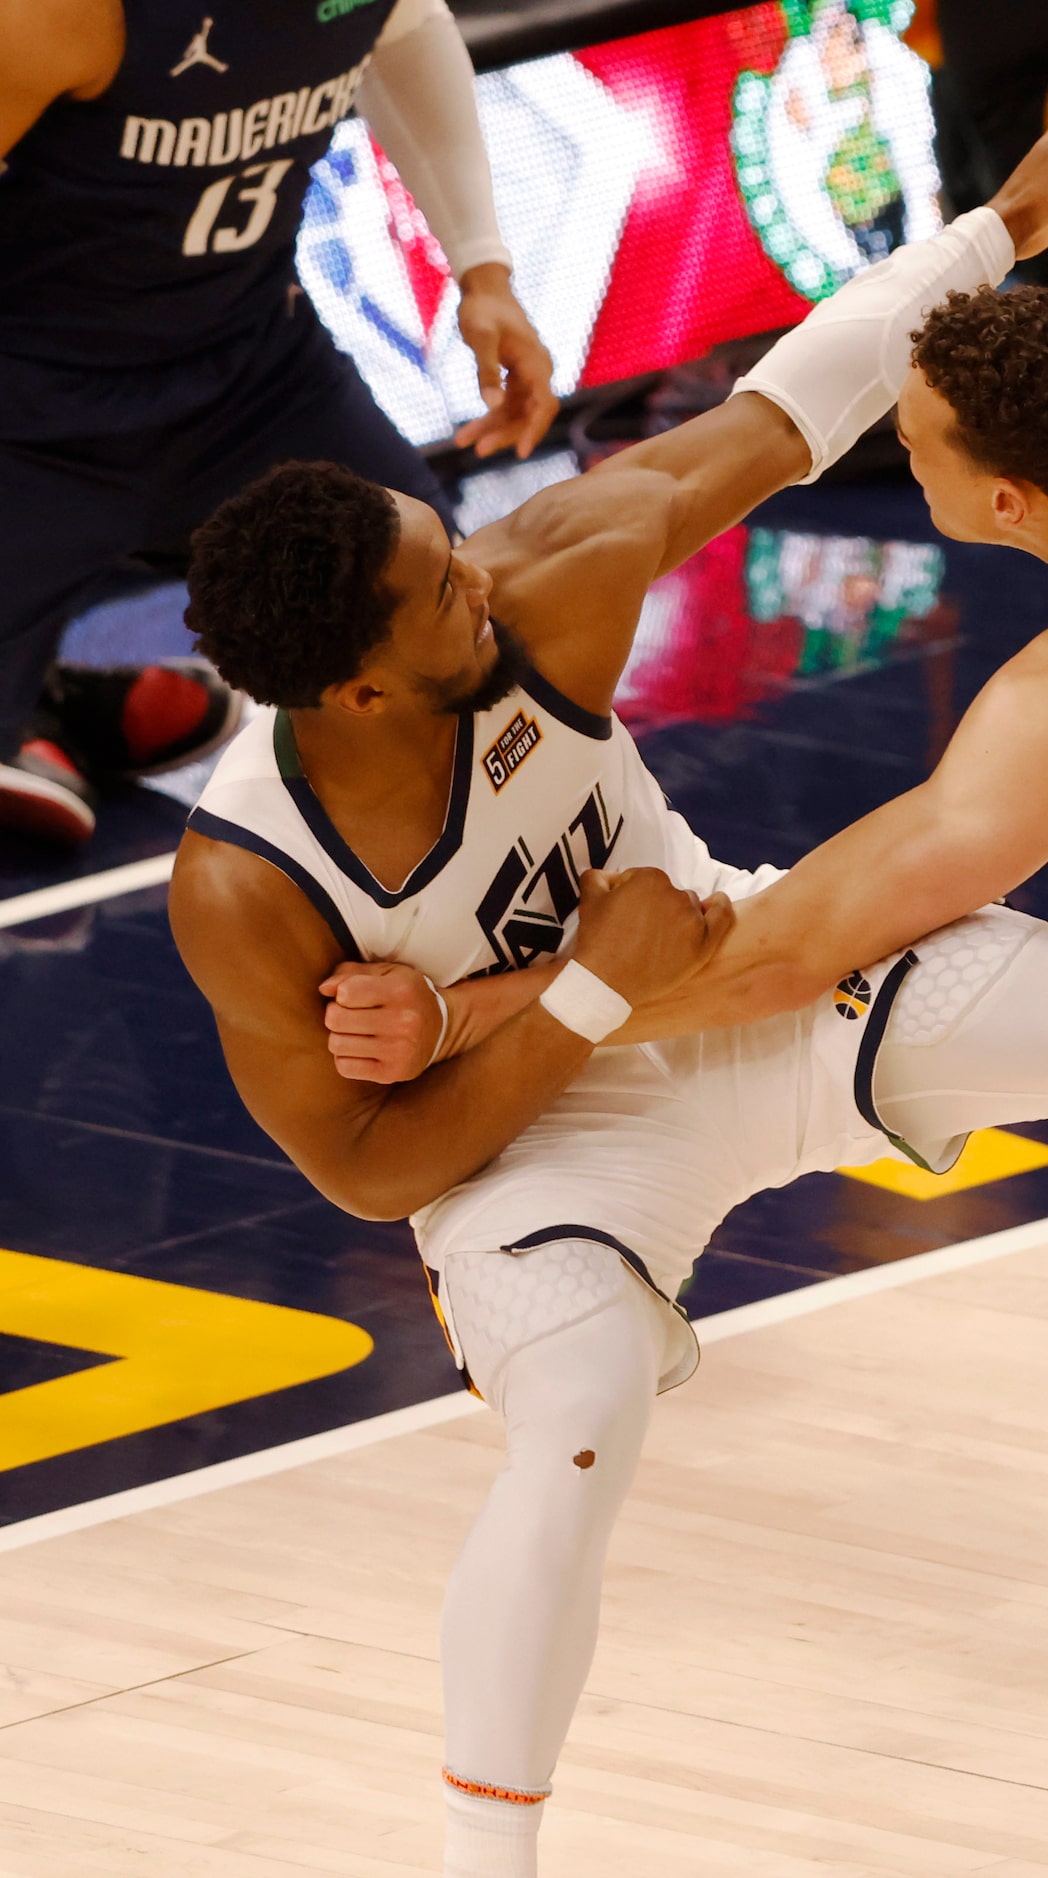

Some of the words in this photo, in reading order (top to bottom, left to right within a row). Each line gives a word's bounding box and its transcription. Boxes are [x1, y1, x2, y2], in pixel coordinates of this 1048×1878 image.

[119, 53, 371, 166] MAVERICK
[182, 159, 295, 257] 13
[500, 731, 513, 749] FOR
[511, 718, 524, 736] THE
[506, 725, 537, 769] FIGHT
[485, 751, 506, 785] 5
